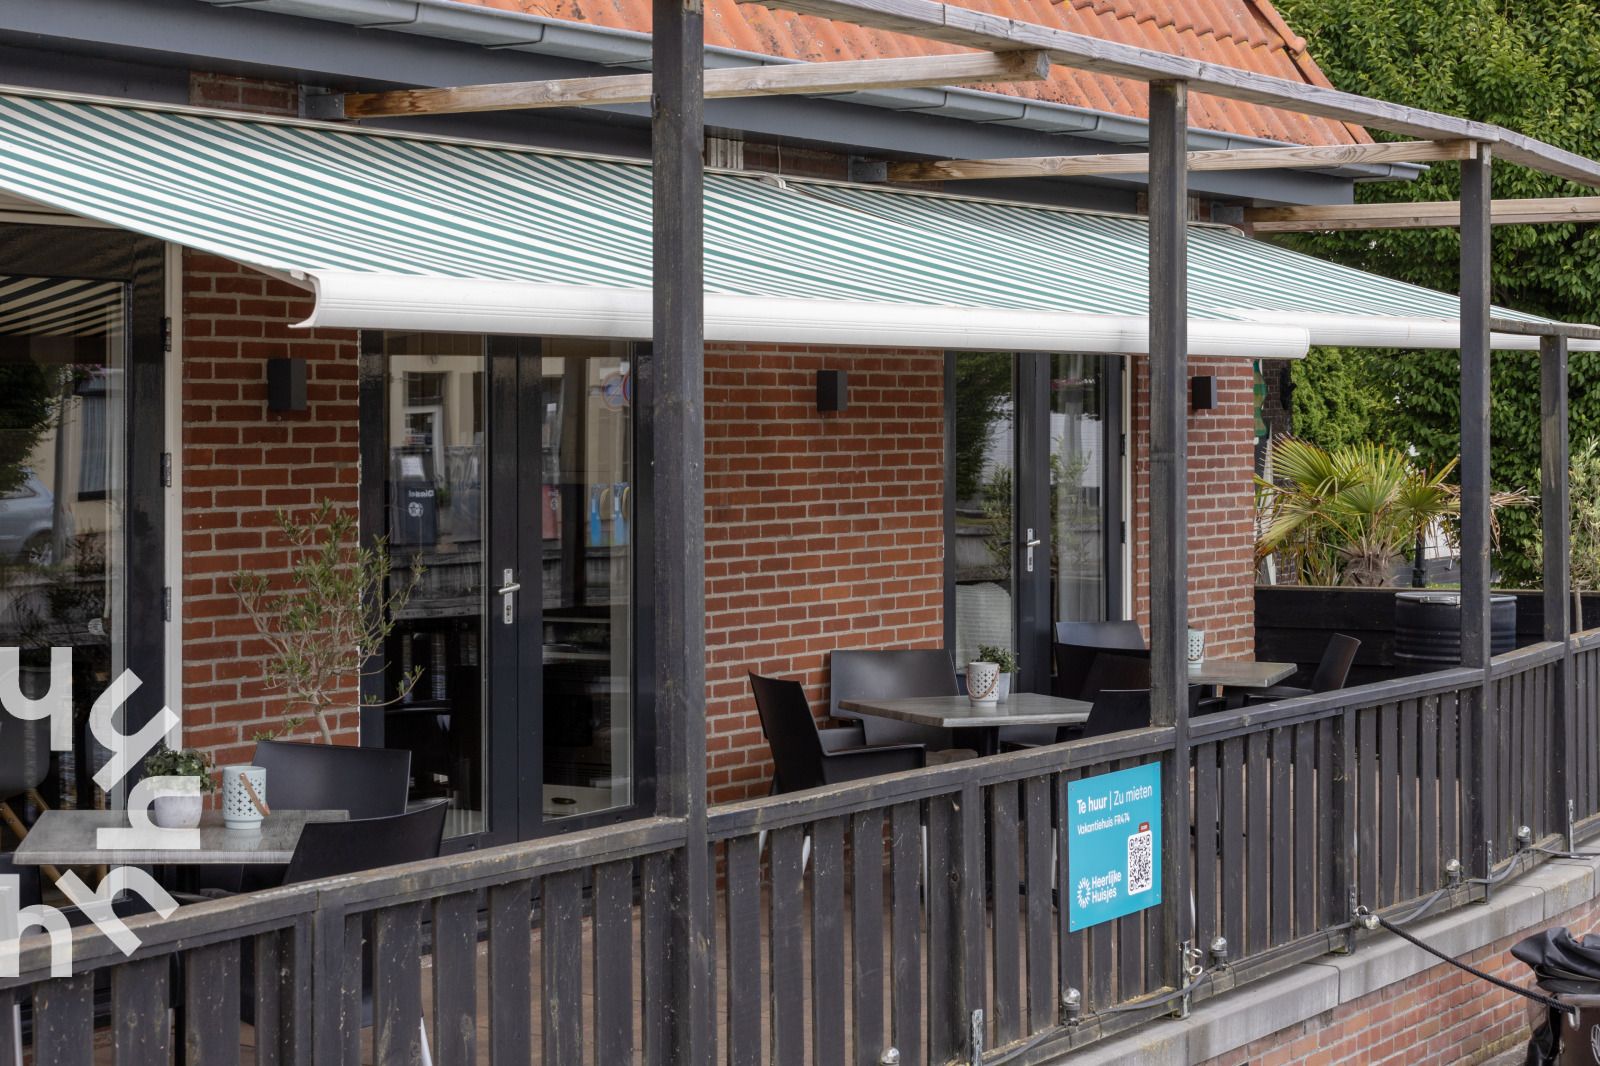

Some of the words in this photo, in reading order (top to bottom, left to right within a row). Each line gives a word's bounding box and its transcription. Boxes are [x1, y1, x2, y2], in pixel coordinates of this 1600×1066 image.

[1077, 799, 1087, 815] Te
[1088, 796, 1108, 812] huur
[1113, 790, 1125, 806] Zu
[1126, 786, 1153, 802] mieten
[1077, 817, 1114, 835] Vakantiehuis
[1091, 870, 1122, 888] Heerlijke
[1091, 886, 1117, 904] Huisjes
